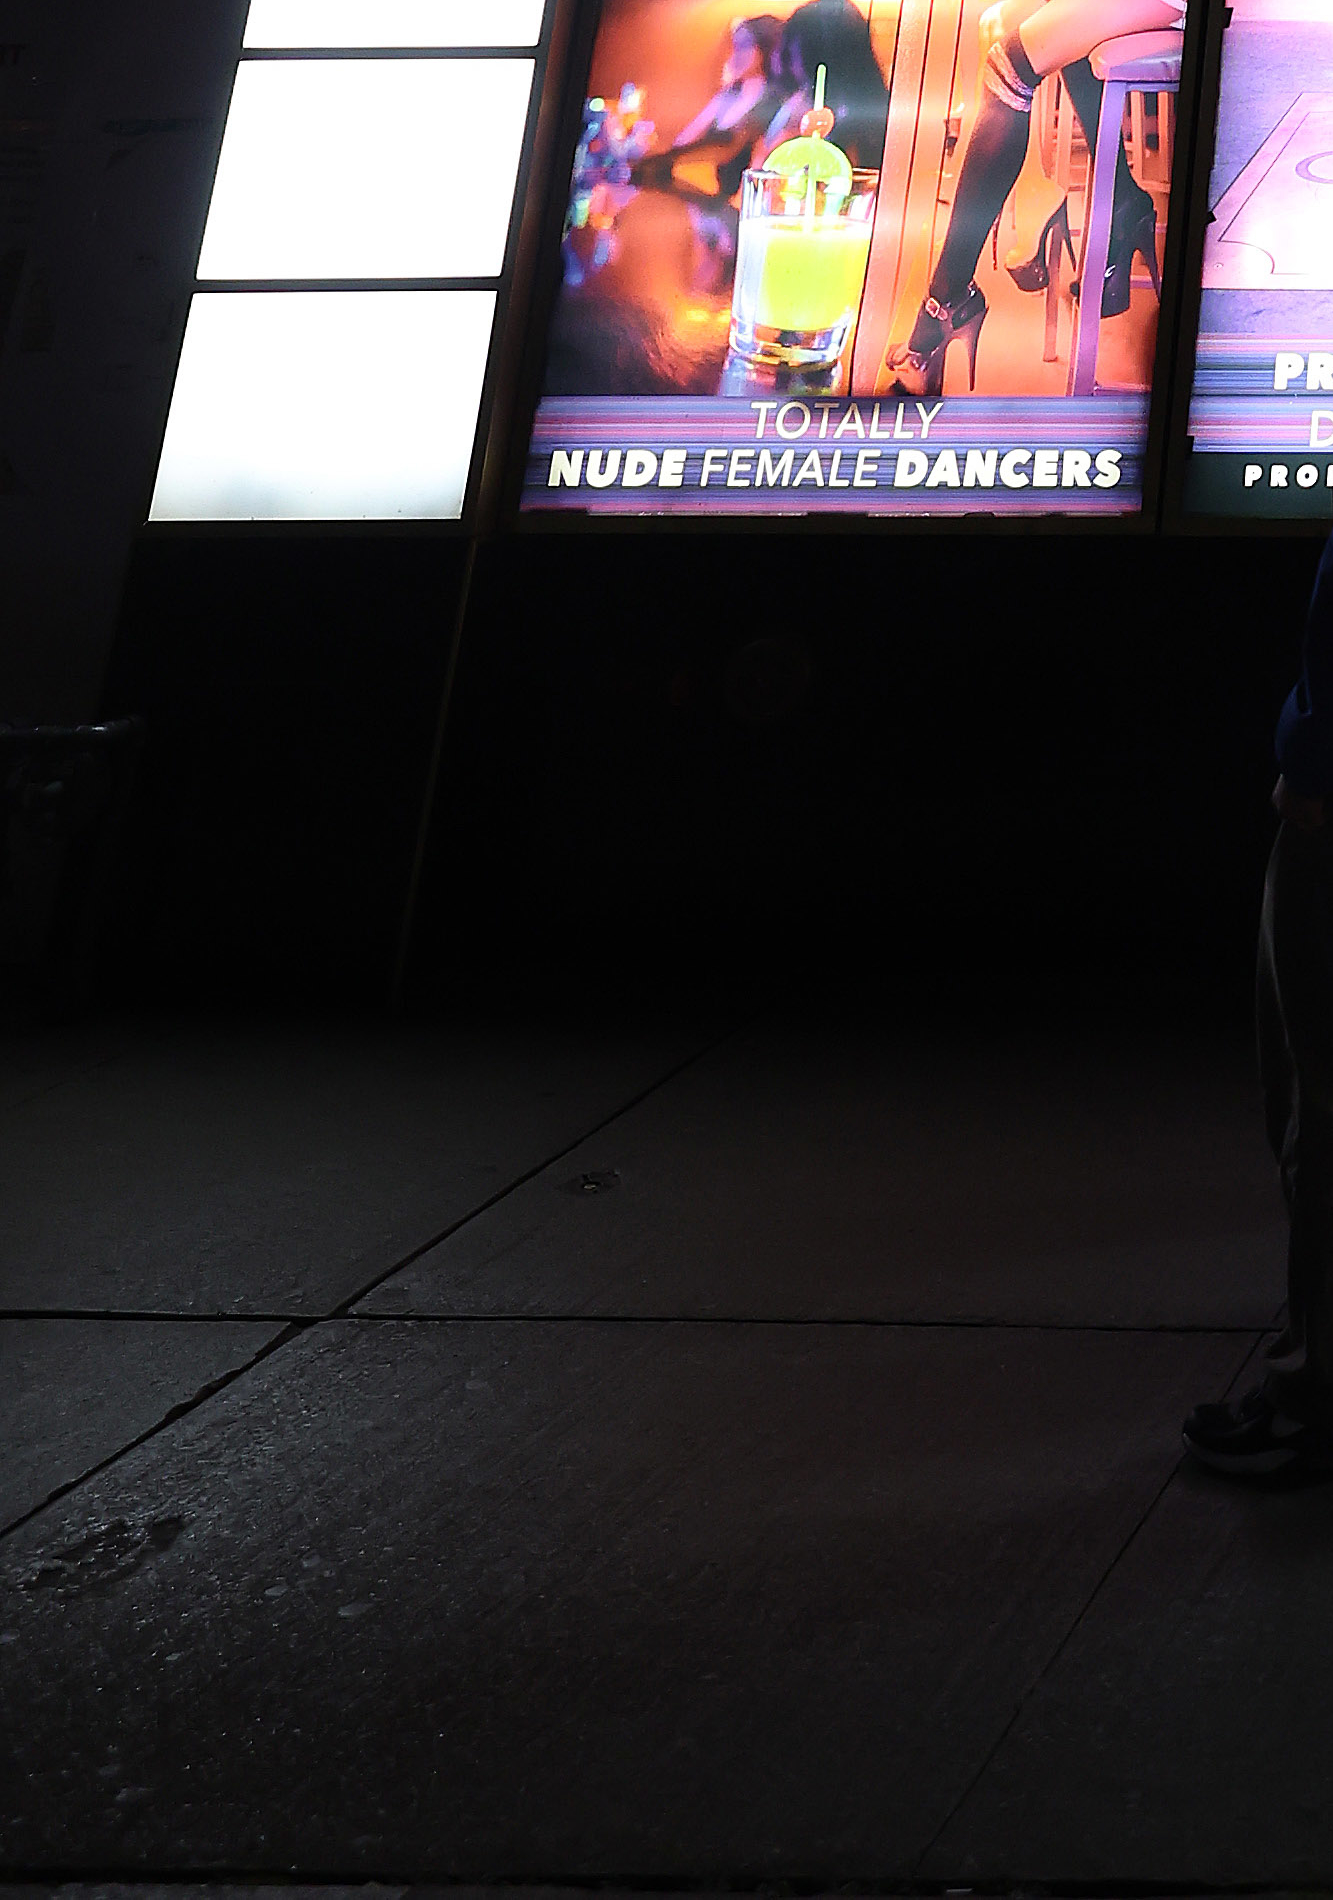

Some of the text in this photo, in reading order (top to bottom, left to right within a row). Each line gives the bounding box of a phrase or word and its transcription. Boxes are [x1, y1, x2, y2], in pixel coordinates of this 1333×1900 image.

[751, 401, 943, 439] TOTALLY
[548, 448, 1121, 488] NUDE FEMALE DANCERS
